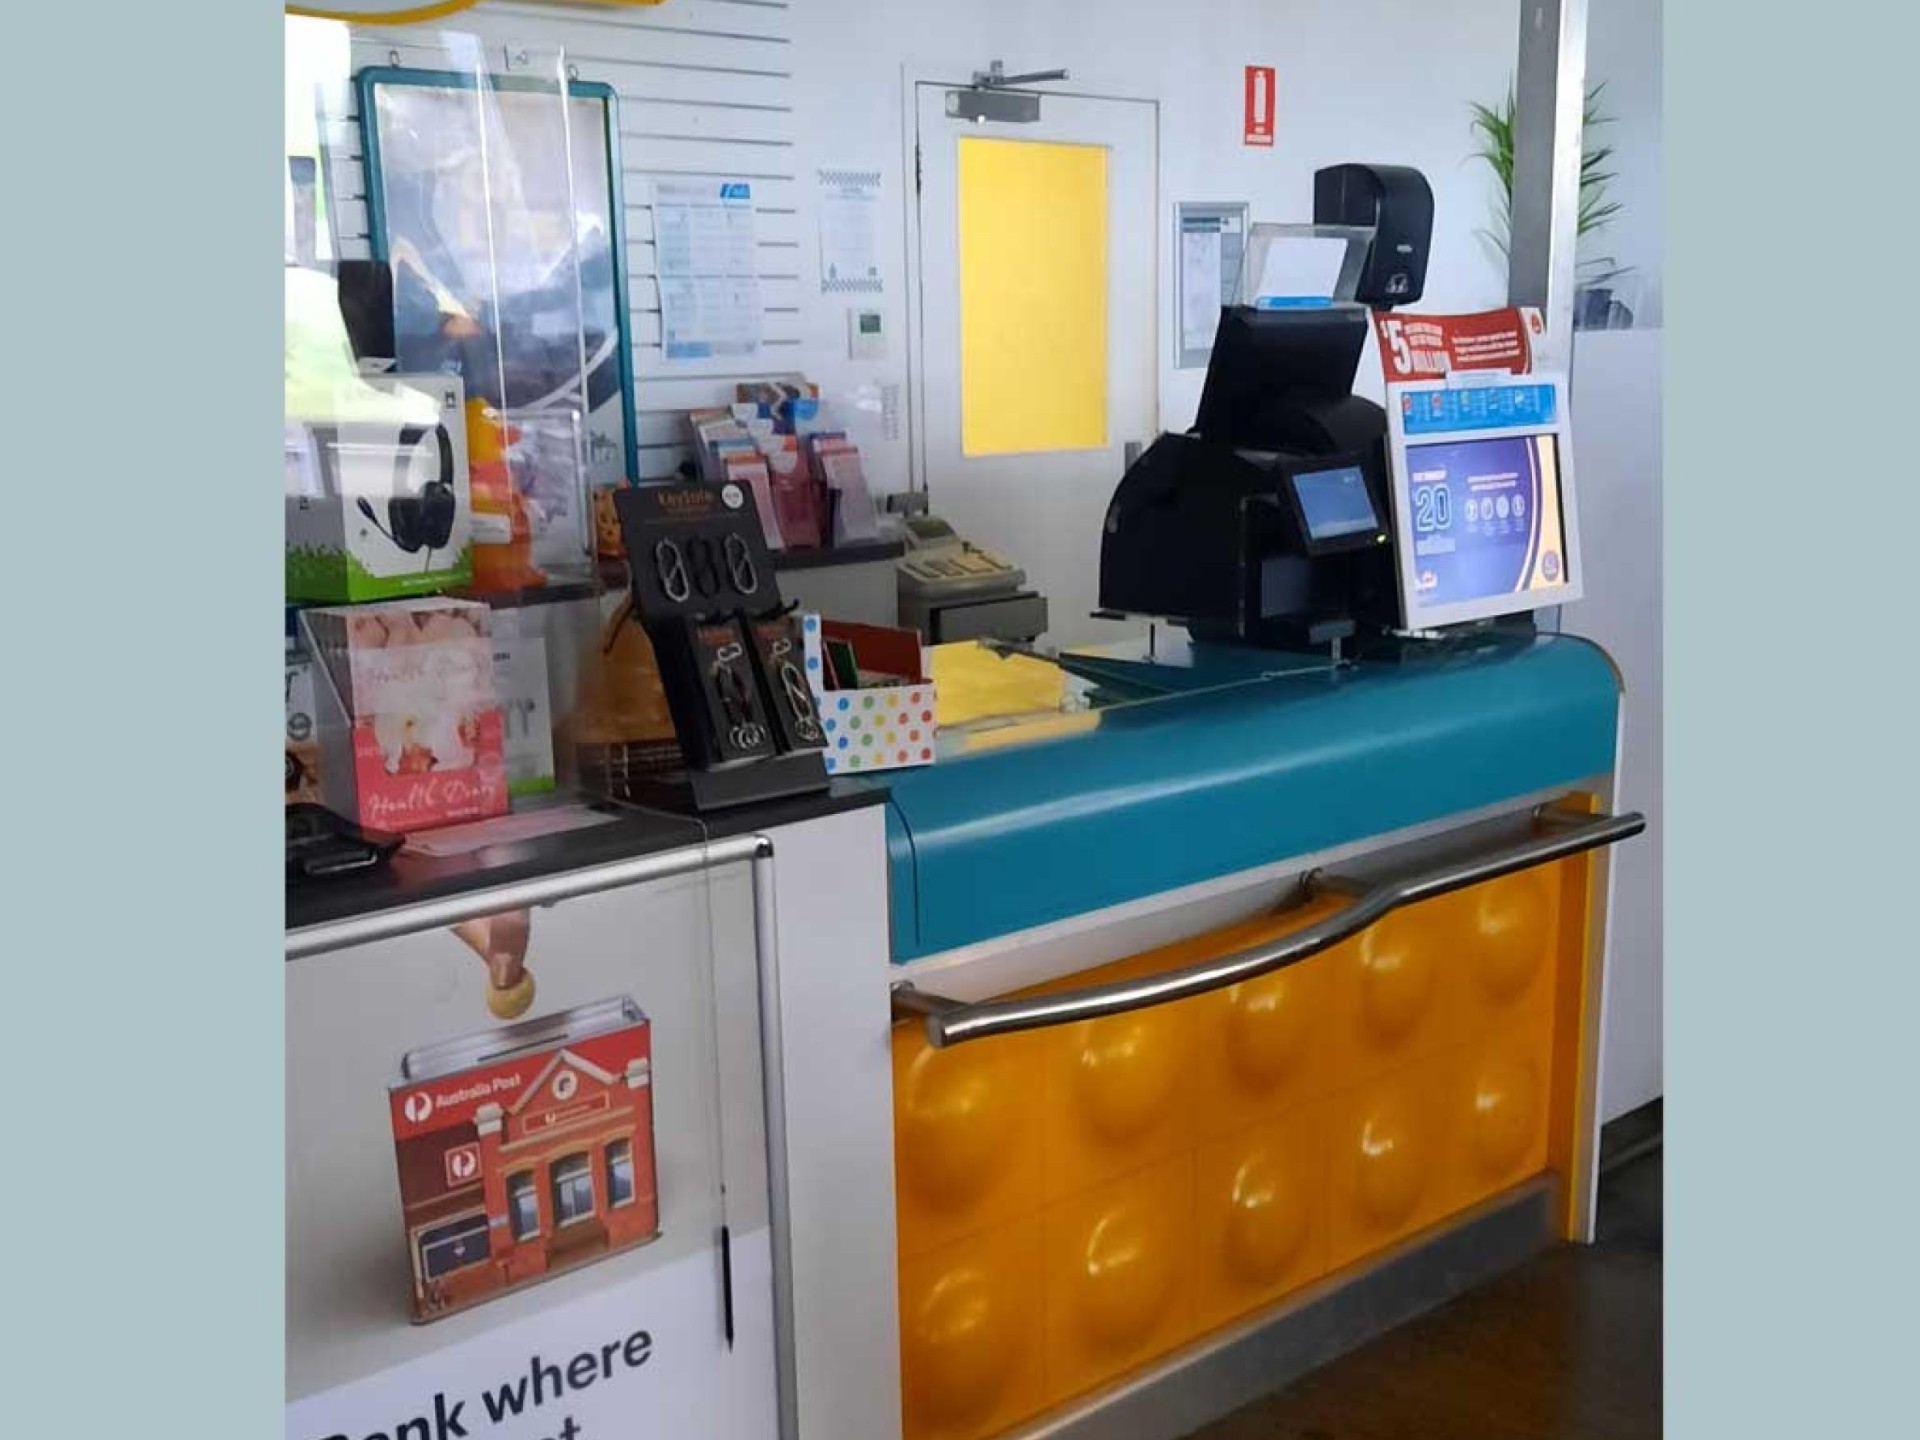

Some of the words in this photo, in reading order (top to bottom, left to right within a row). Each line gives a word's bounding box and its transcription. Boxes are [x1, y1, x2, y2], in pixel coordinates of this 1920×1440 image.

[1415, 483, 1452, 532] 20
[369, 777, 438, 821] Health
[434, 1082, 490, 1109] Australia
[491, 1073, 521, 1092] Post
[480, 1330, 652, 1424] where
